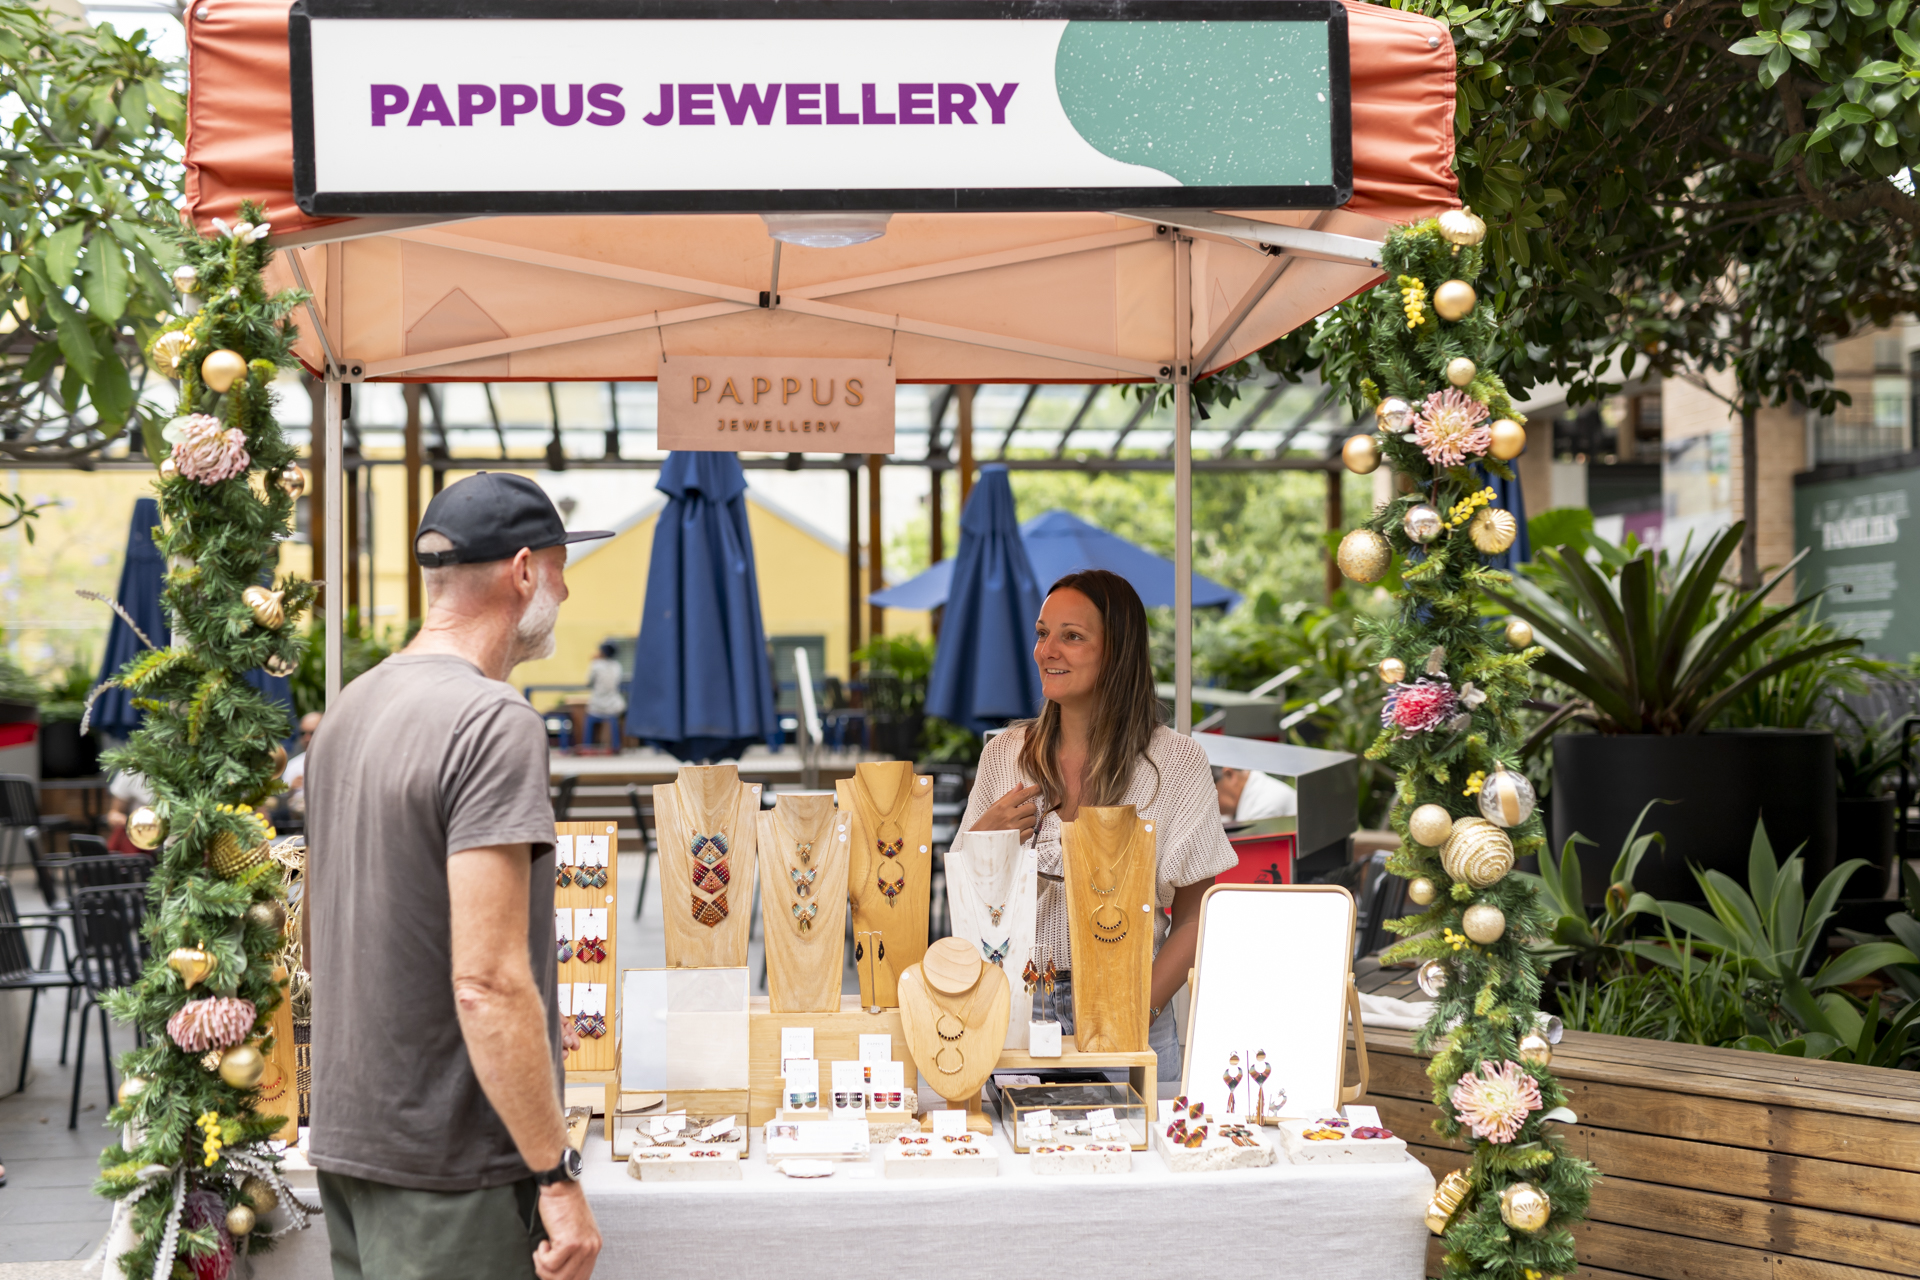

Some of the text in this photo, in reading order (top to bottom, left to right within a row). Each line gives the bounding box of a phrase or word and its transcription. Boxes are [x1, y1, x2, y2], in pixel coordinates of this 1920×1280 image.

[370, 82, 1020, 127] PAPPUS JEWELLERY
[691, 374, 865, 407] PAPPUS
[717, 418, 841, 433] JEWELLERY
